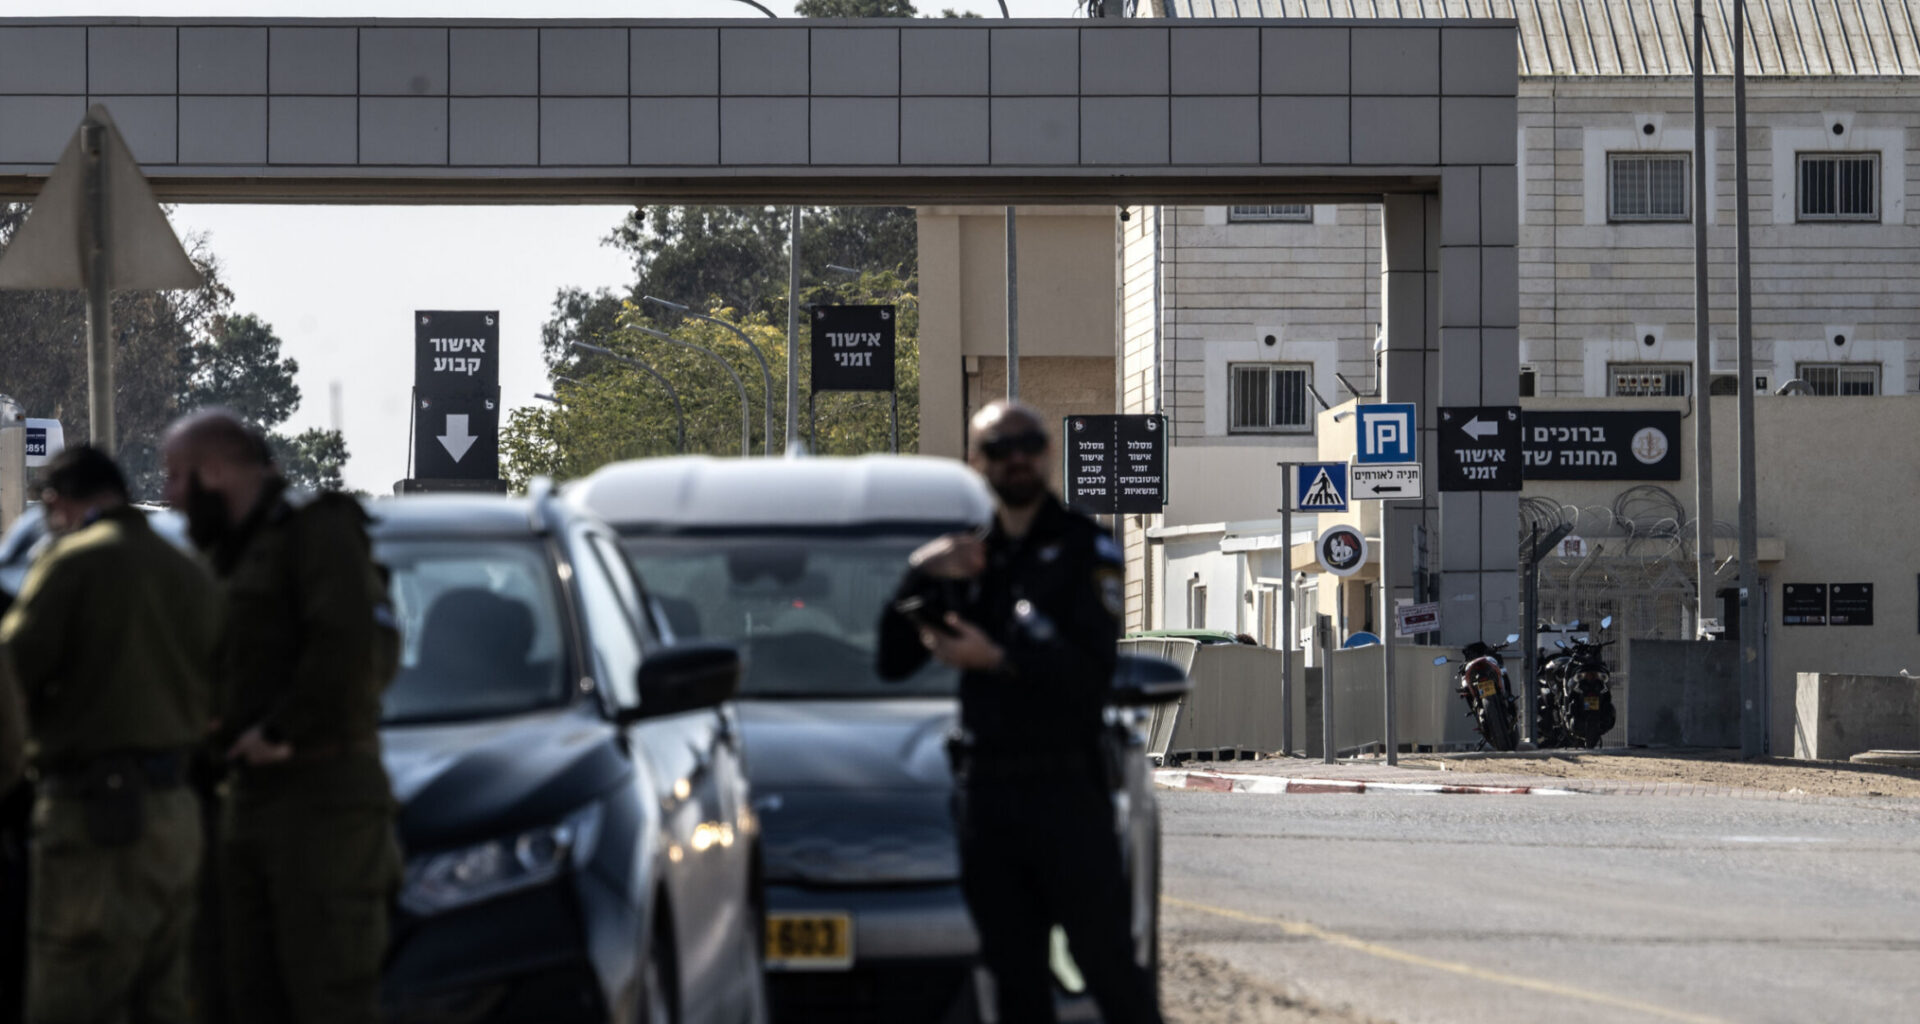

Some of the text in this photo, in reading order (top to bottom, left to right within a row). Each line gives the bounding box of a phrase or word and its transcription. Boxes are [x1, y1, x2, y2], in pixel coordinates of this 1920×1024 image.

[825, 332, 881, 347] אישור
[429, 337, 486, 353] אישור
[833, 351, 873, 367] זמני
[433, 357, 481, 376] קבוע
[1533, 426, 1606, 443] ברוכים
[1078, 440, 1105, 450] מסלול
[1127, 440, 1153, 450] מסלול
[1079, 453, 1104, 462] אישור
[1127, 453, 1152, 461] אישור
[1454, 448, 1506, 463] אישור
[1560, 450, 1618, 466] מחנה
[1081, 465, 1102, 474] קבוע
[1131, 464, 1148, 473] זמני
[1462, 465, 1498, 480] זמני
[1077, 475, 1107, 485] לרכבים
[1119, 475, 1161, 484] אוטובוסים
[1354, 469, 1418, 481] חניה לאורחים
[1077, 487, 1107, 496] פרטיים
[1123, 487, 1158, 496] ומשאיות
